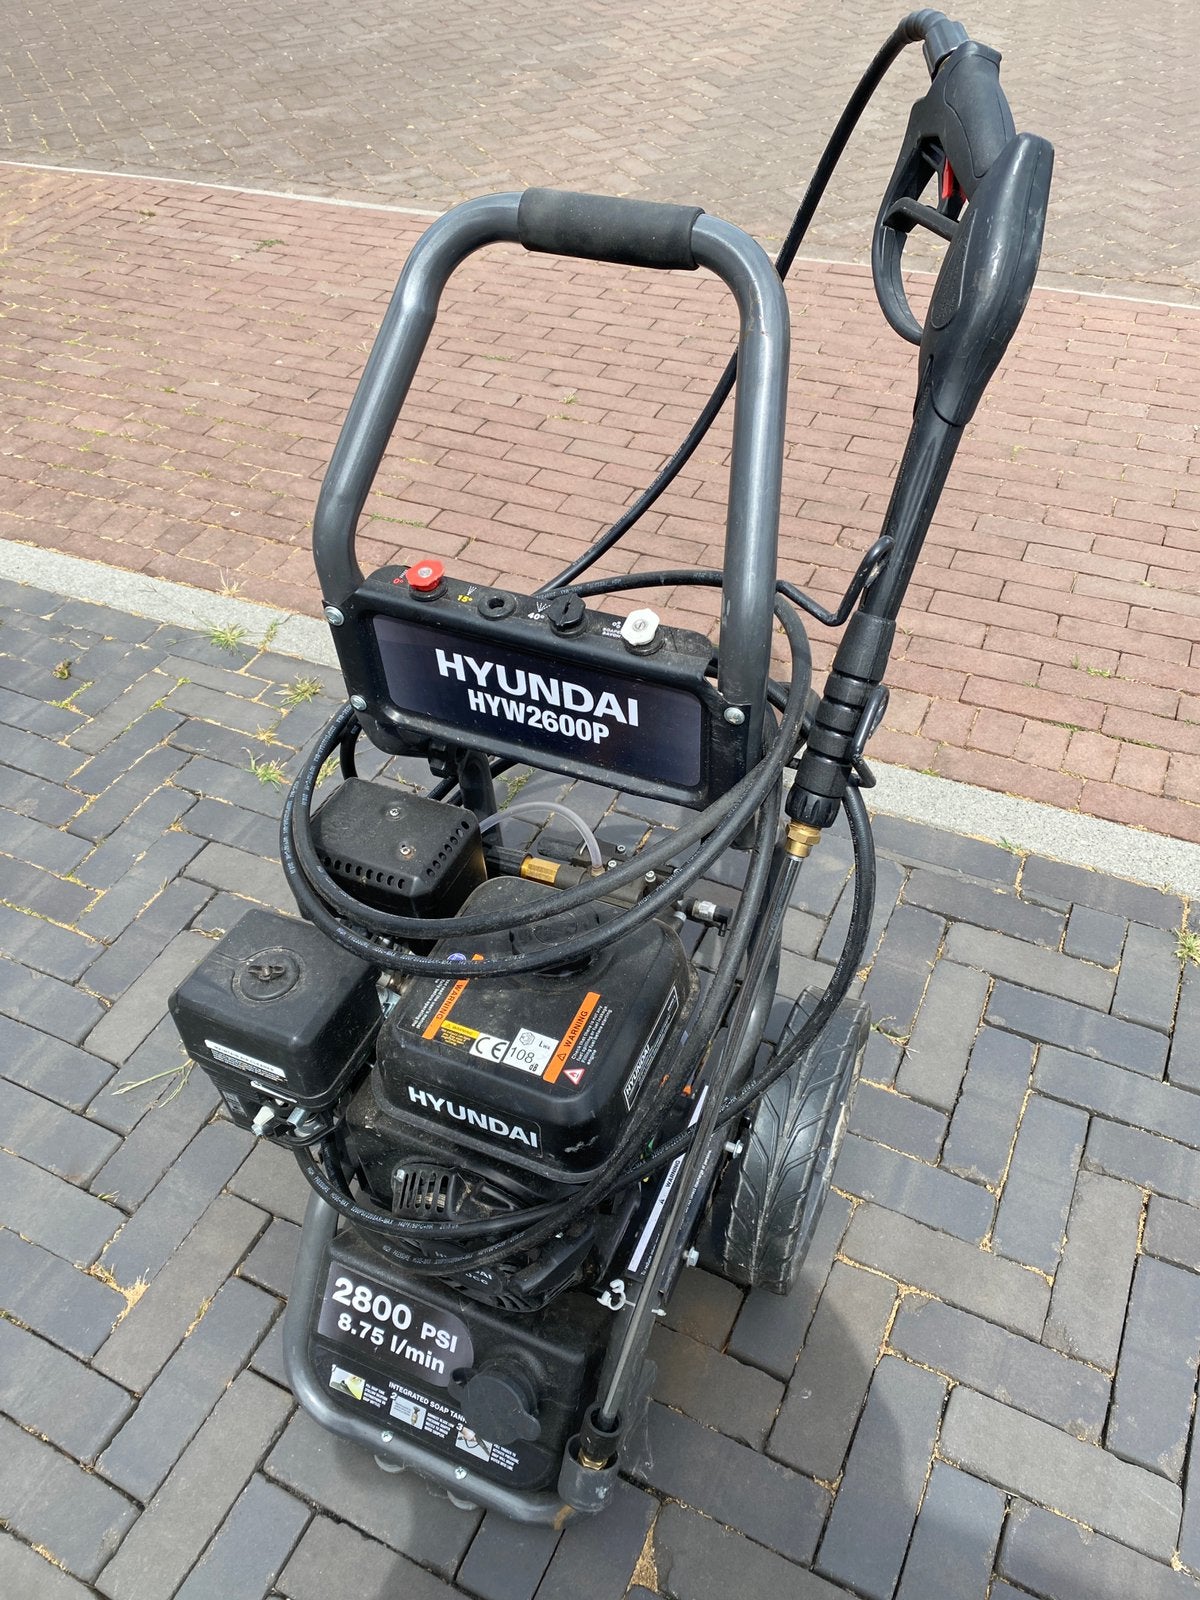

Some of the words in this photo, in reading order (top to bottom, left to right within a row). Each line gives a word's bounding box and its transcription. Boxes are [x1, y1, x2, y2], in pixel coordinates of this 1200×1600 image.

[457, 594, 473, 603] 15°
[527, 612, 545, 620] 40°
[434, 648, 639, 727] HYUNDAI
[467, 688, 610, 744] HYW2600P
[436, 983, 463, 1020] WARNING
[564, 1010, 588, 1048] WARNING
[570, 1044, 581, 1060] Check
[578, 1035, 586, 1045] that
[583, 1024, 592, 1036] there
[575, 1051, 584, 1061] fuel
[591, 1021, 599, 1031] fuel
[588, 1039, 596, 1048] fuel
[475, 1036, 507, 1060] CE
[511, 1047, 535, 1064] 108
[528, 1063, 539, 1072] dB
[408, 1085, 538, 1148] HYUNDAI
[665, 1160, 681, 1188] WARNING
[332, 1277, 412, 1330] 2800
[420, 1322, 458, 1353] PSI
[337, 1313, 385, 1345] 8.75
[390, 1335, 445, 1374] l/min
[388, 1381, 429, 1405] INTEGRATED
[429, 1400, 450, 1414] SOAP
[390, 1391, 397, 1400] 2
[456, 1423, 463, 1431] 3
